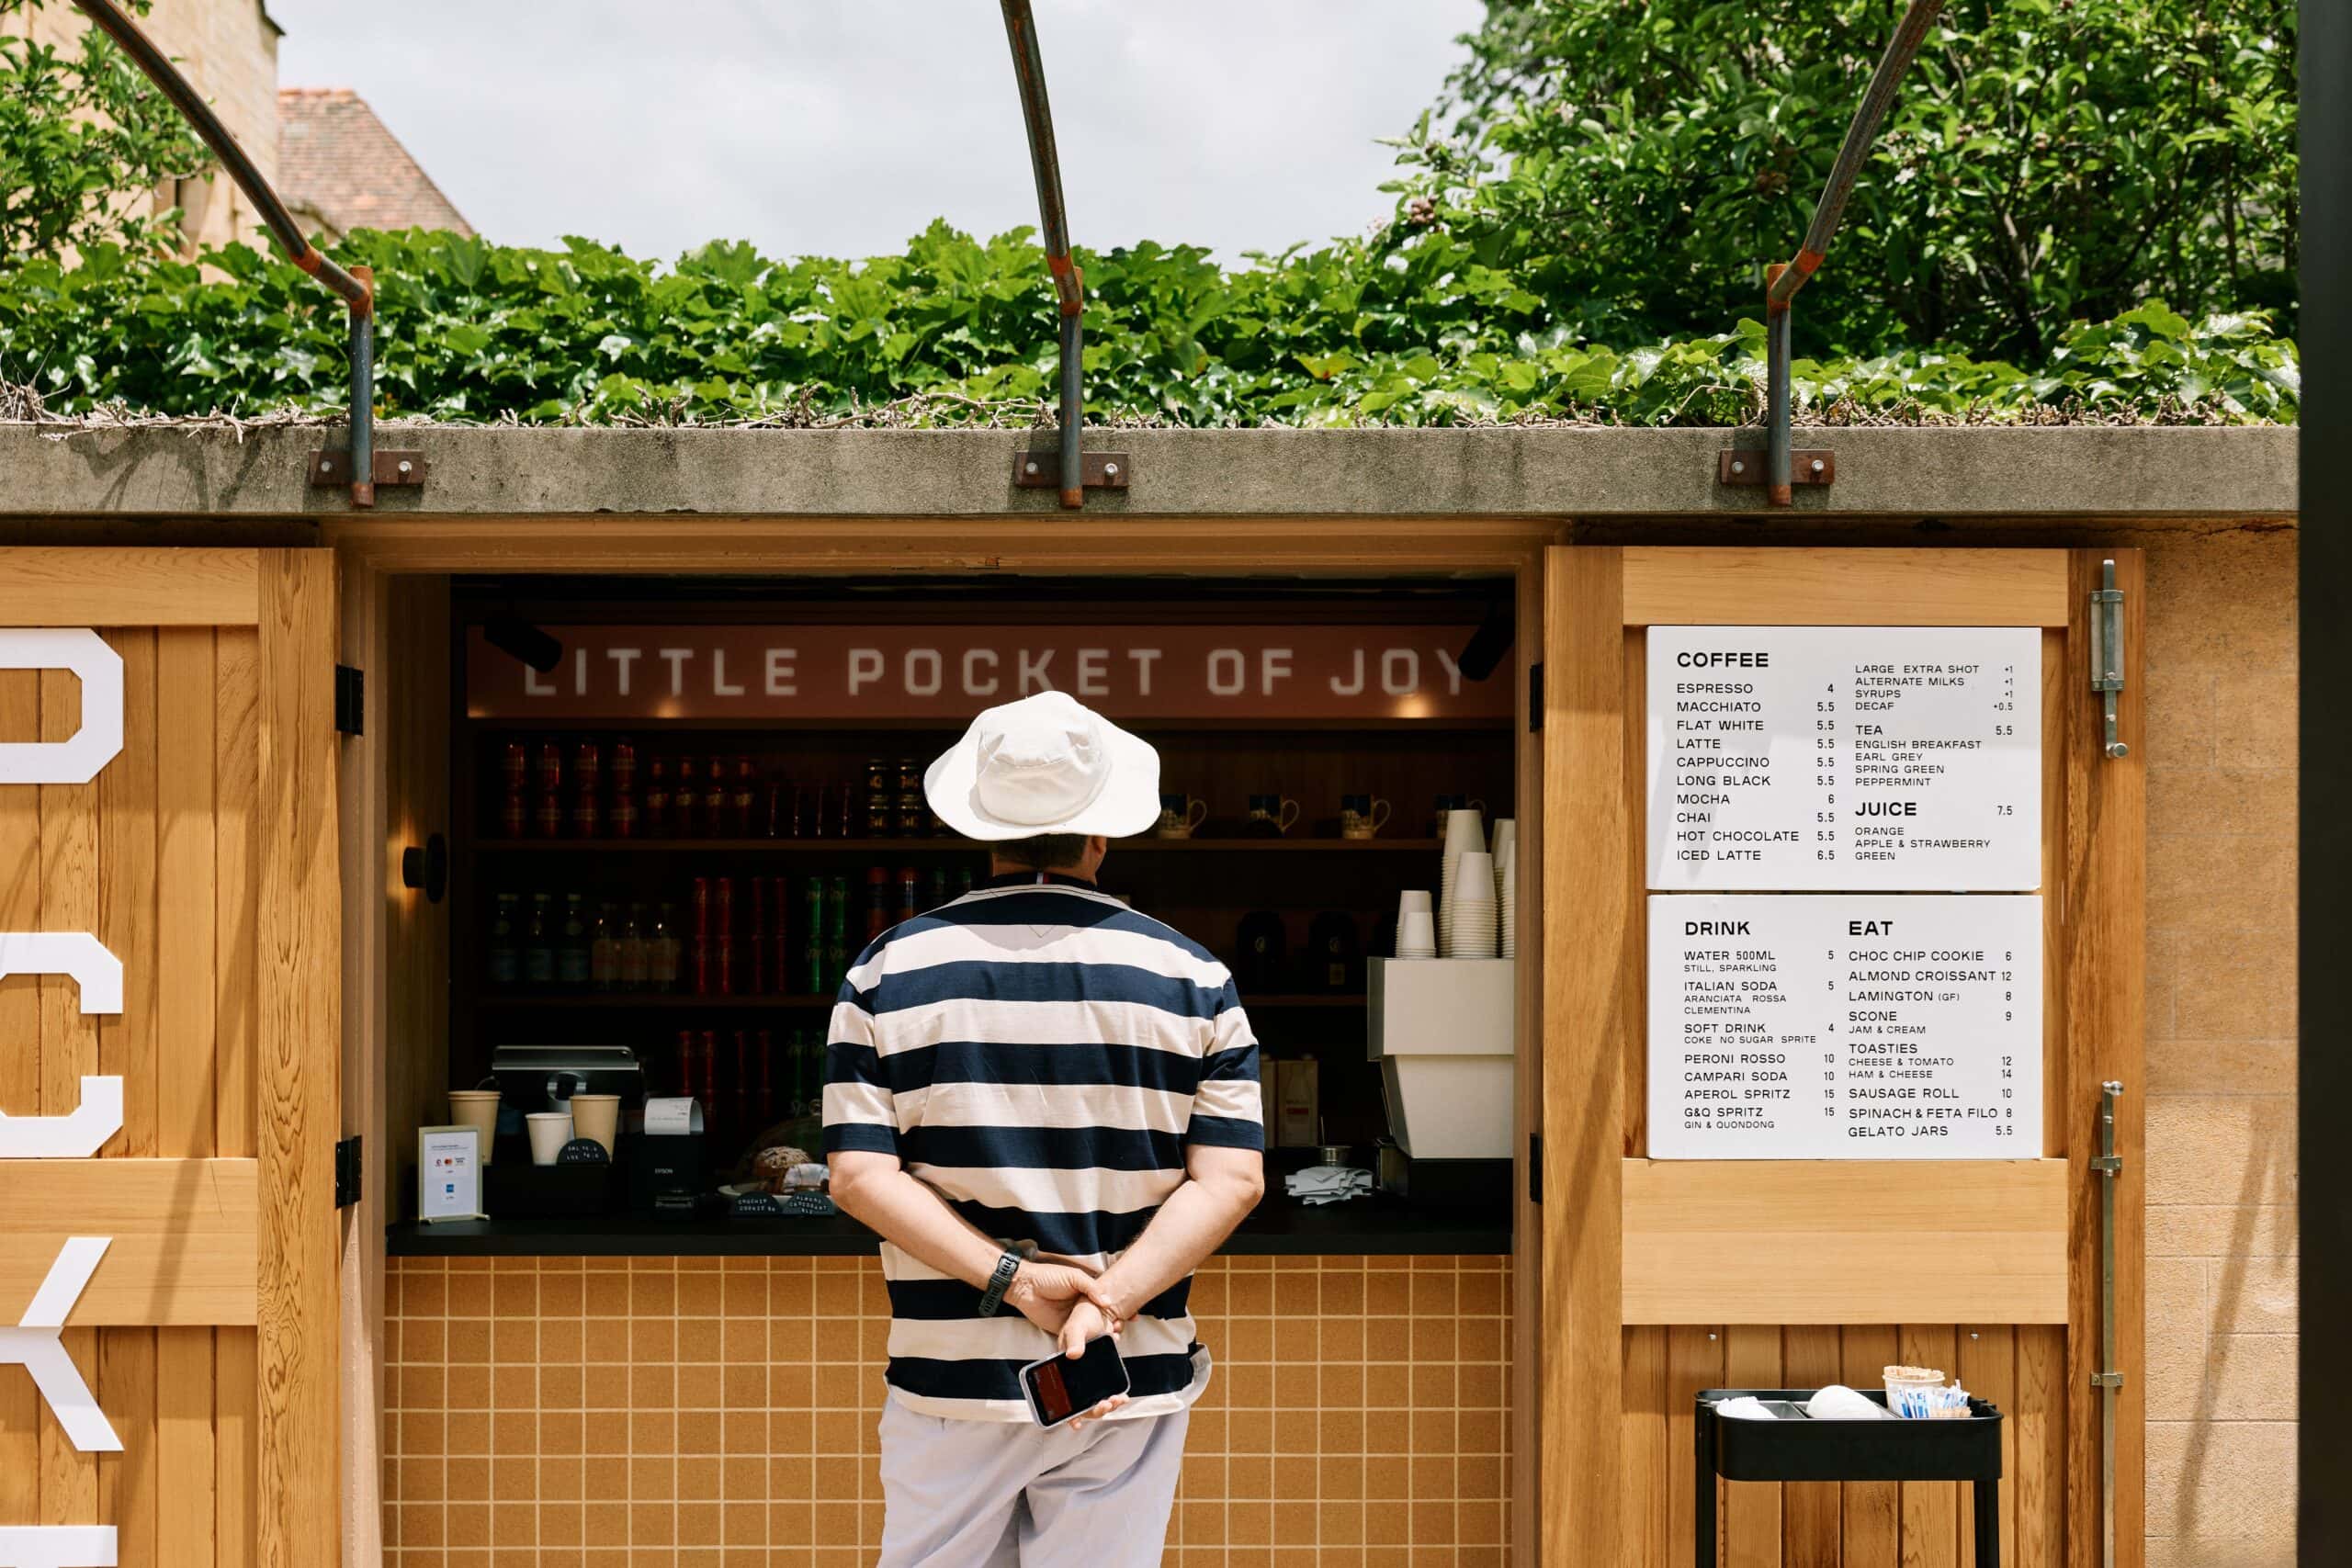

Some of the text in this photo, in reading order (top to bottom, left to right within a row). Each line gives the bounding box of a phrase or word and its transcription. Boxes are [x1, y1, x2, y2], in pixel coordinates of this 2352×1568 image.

[1676, 651, 1770, 668] COFFEE
[526, 649, 1461, 695] LITTLE POCKET OF JOY
[1854, 664, 1895, 674] LARGE
[1903, 664, 1942, 674] EXTRA
[1947, 664, 1980, 674] SHOT
[1854, 676, 1923, 686] ALTERNATE
[1928, 676, 1965, 686] MILKS
[1676, 682, 1835, 694] ESPRESSO 4
[1854, 688, 1902, 698] SYRUPS
[1676, 701, 1836, 714] MACCHIATO 5.5
[1854, 701, 1895, 711] DECAF
[1676, 719, 1836, 731] FLAT WHITE 5.5
[1854, 725, 2013, 736] TEA 5.5
[1676, 738, 1836, 750] LATTE 5.5
[1854, 739, 1983, 750] ENGLISH BREAKFAST
[1854, 751, 1924, 761] EARL GREY
[1676, 756, 1836, 769] CAPPUCCINO 5.5
[1854, 764, 1945, 774] SPRING GREEN
[1676, 774, 1836, 787] LONG BLACK 5.5
[1854, 776, 1931, 787] PEPPERMINT
[1676, 793, 1836, 806] MOCHA 6
[1854, 801, 2013, 817] JUICE 7.5
[1676, 811, 1836, 824] CHAI 5.5
[1676, 829, 1836, 842] HOT CHOCOLATE 5.5
[1854, 826, 1905, 836] ORANGE
[1854, 839, 1991, 849] APPLE & STRAWBERRY
[1676, 849, 1836, 861] ICED LATTE 6.5
[1854, 851, 1896, 861] GREEN
[1684, 920, 1751, 936] DRINK
[1848, 920, 1894, 936] EAT
[1683, 949, 1835, 962] WATER 500ML 5
[1848, 950, 2013, 963] CHOC CHIP COOKIE 6
[1719, 964, 1778, 973] SPARKLING
[1848, 970, 2013, 982] ALMOND CROISSANT 12
[1683, 980, 1835, 992] ITALIAN SODA 5
[1683, 994, 1787, 1003] ARANCIATA ROSSA
[1848, 990, 1934, 1002] LAMINGTON
[2005, 990, 2013, 1002] 8
[1683, 1006, 1751, 1015] CLEMENTINA
[1848, 1010, 2013, 1023] SCONE 9
[1683, 1021, 1835, 1034] SOFT DRINK 4
[1848, 1025, 1927, 1035] JAM & CREAM
[1683, 1035, 1816, 1044] COKE NO SUGAR SPRITE
[1848, 1043, 1918, 1055] TOASTIES
[1683, 1053, 1836, 1066] PERONI ROSSO 10
[1848, 1055, 2013, 1066] CHEESE & TOMATO 12
[1683, 1070, 1836, 1083] CAMPARI SODA 10
[1848, 1068, 2013, 1079] HAM & CHEESE 14
[1683, 1089, 1836, 1100] APEROL SPRITZ 15
[1848, 1088, 2013, 1100] SAUSAGE ROLL 10
[1716, 1106, 1764, 1119] SPRITZ
[1823, 1106, 1836, 1118] 15
[1848, 1107, 2013, 1120] SPINACH & FETA FILO 8
[1683, 1120, 1775, 1130] GIN & QUONDONG
[1848, 1125, 2013, 1138] GELATO JARS 5.5
